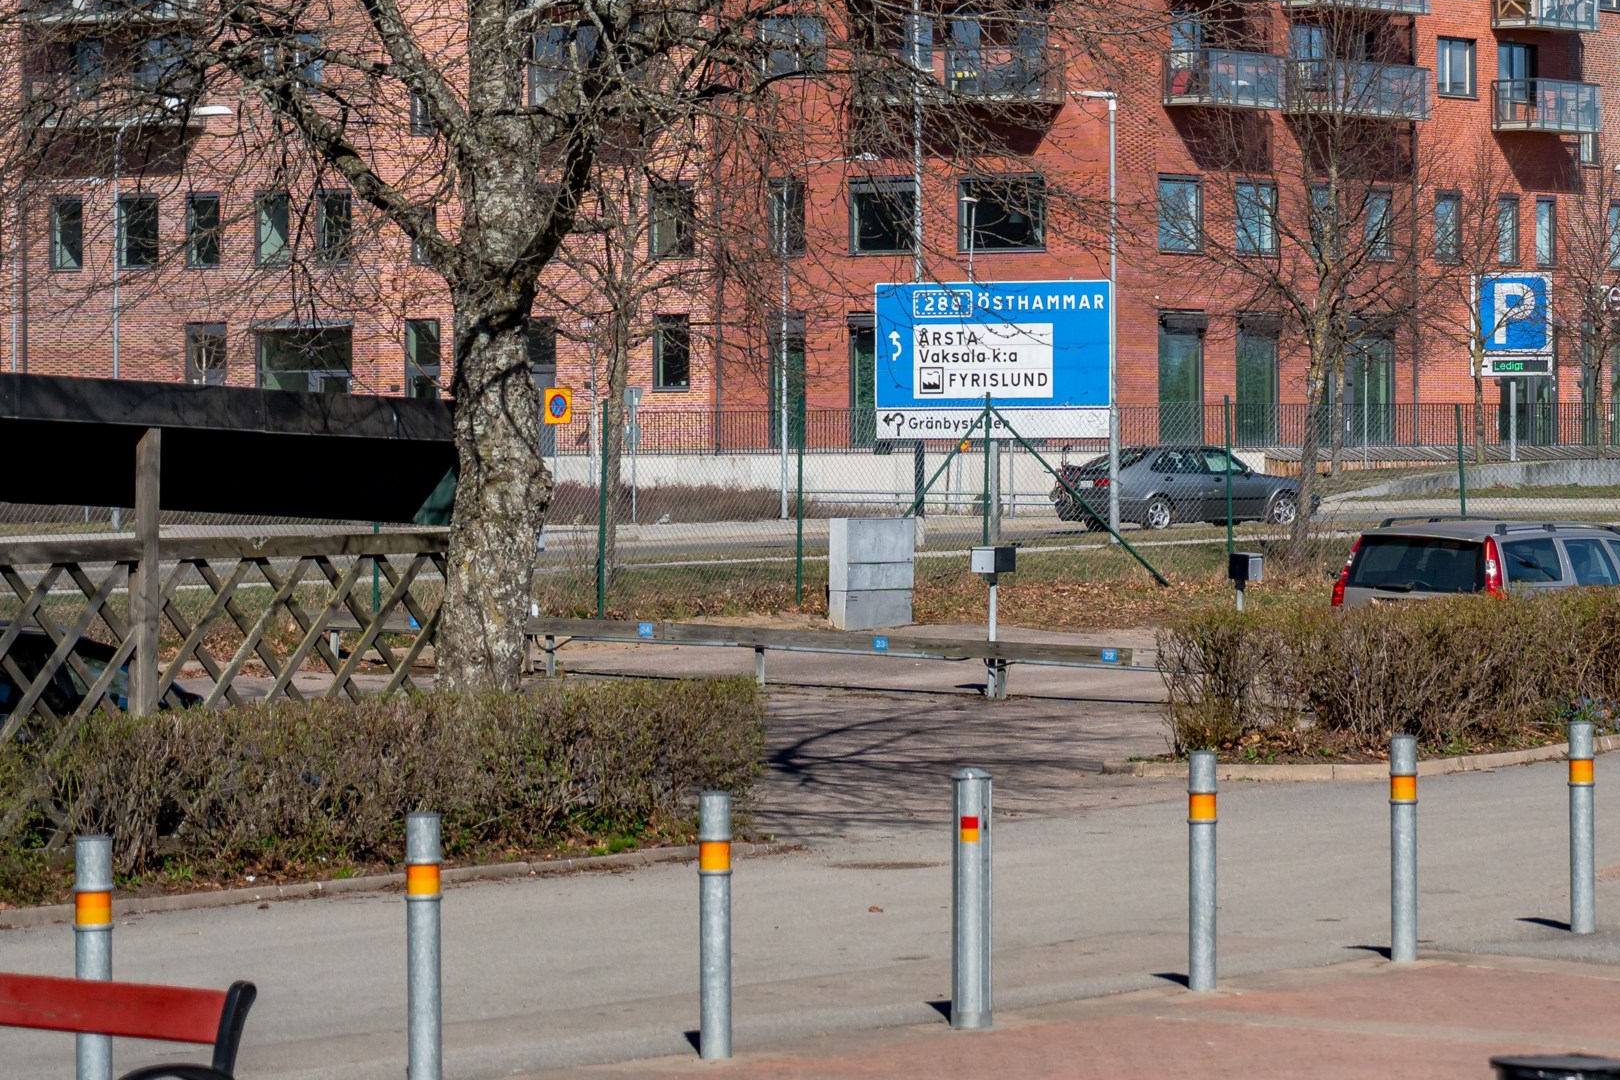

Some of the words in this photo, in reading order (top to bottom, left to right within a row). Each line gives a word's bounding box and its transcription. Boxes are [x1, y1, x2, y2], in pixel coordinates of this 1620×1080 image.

[924, 296, 962, 312] 288
[977, 292, 1105, 311] ÖSTHAMMAR
[1494, 283, 1536, 345] P
[919, 327, 978, 346] ÅRSTA
[919, 349, 986, 363] Vaksala
[992, 349, 1018, 363] k:a
[1493, 361, 1524, 371] Ledigt
[949, 373, 1048, 387] FYRISLUND
[875, 639, 886, 648] 23
[1104, 651, 1115, 660] 22
